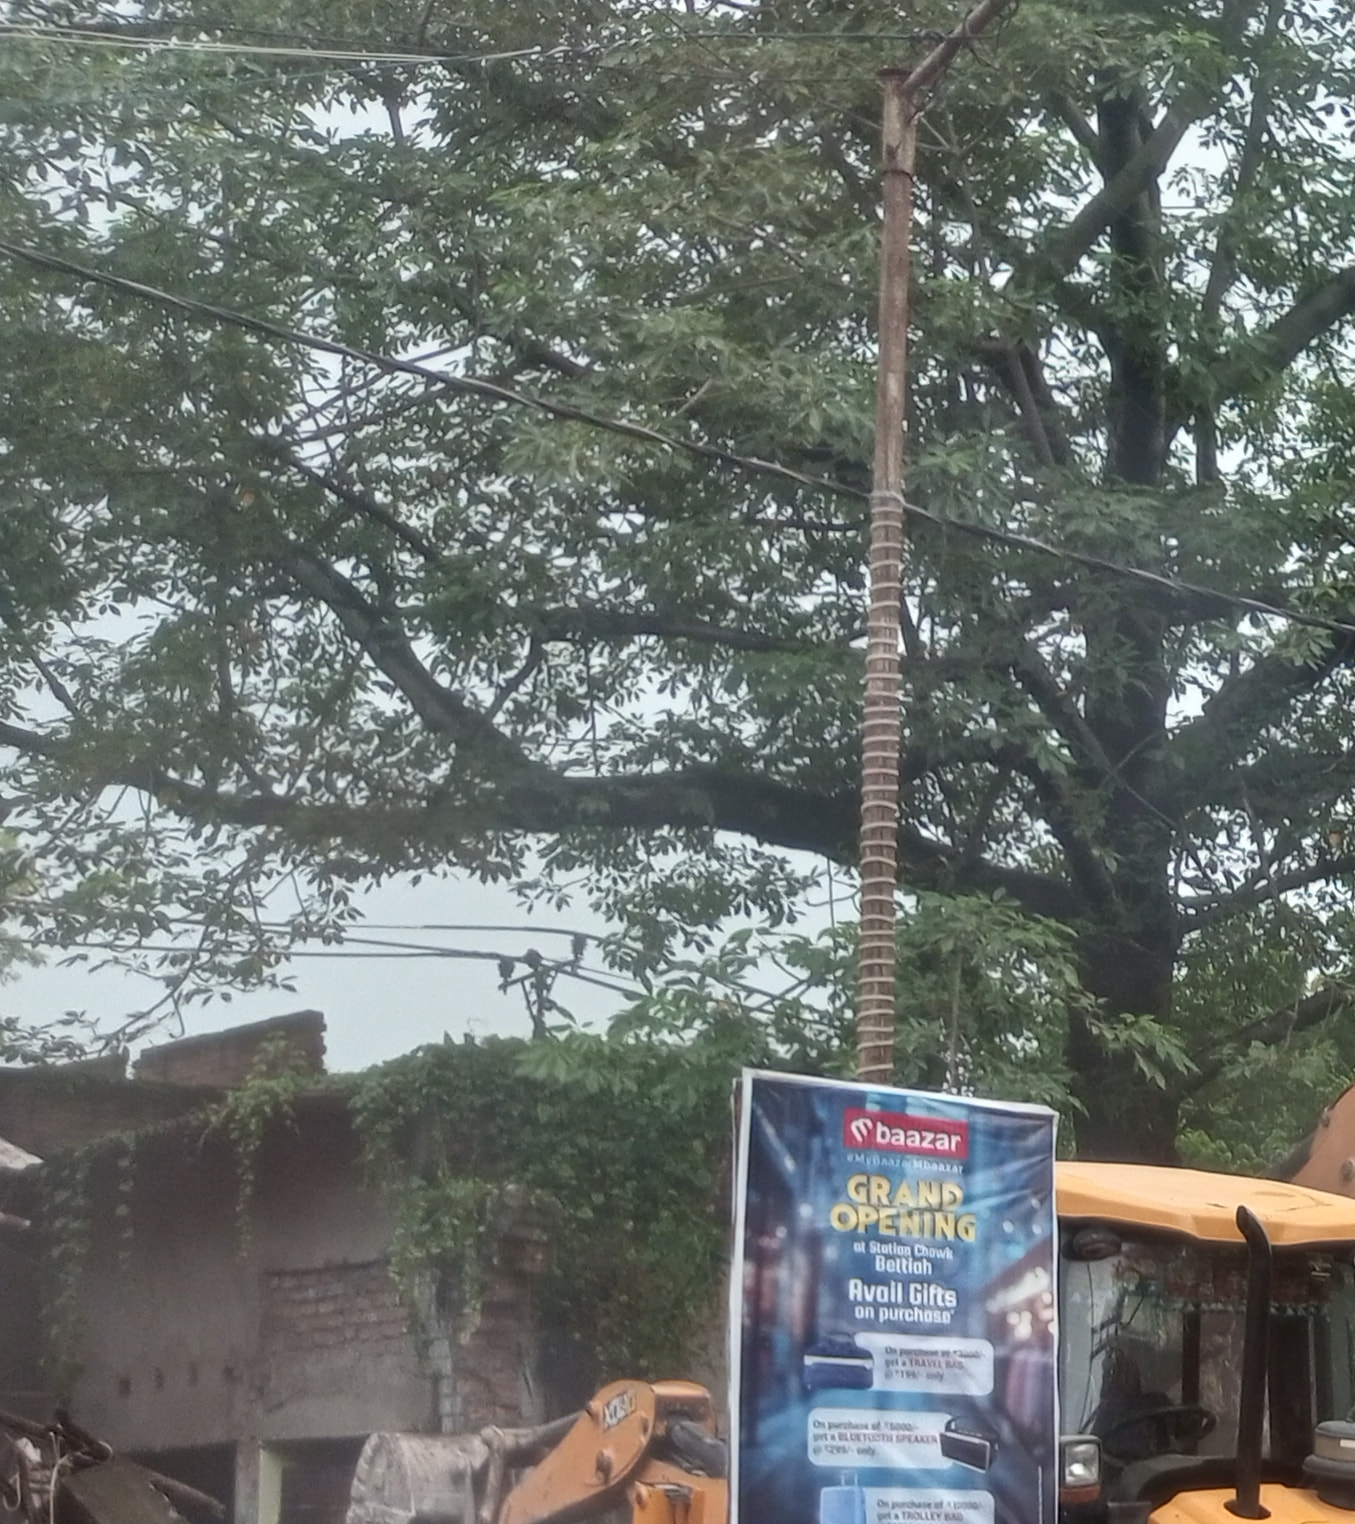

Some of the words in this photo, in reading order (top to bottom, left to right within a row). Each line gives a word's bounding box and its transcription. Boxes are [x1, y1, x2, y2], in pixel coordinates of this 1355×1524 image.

[847, 1174, 963, 1210] GRAND
[829, 1203, 977, 1242] OPENING
[869, 1240, 911, 1257] Station
[914, 1243, 953, 1260] Chowk
[875, 1255, 932, 1275] Bettiah
[848, 1279, 902, 1304] Avail
[909, 1282, 957, 1308] Gifts
[854, 1306, 875, 1320] on
